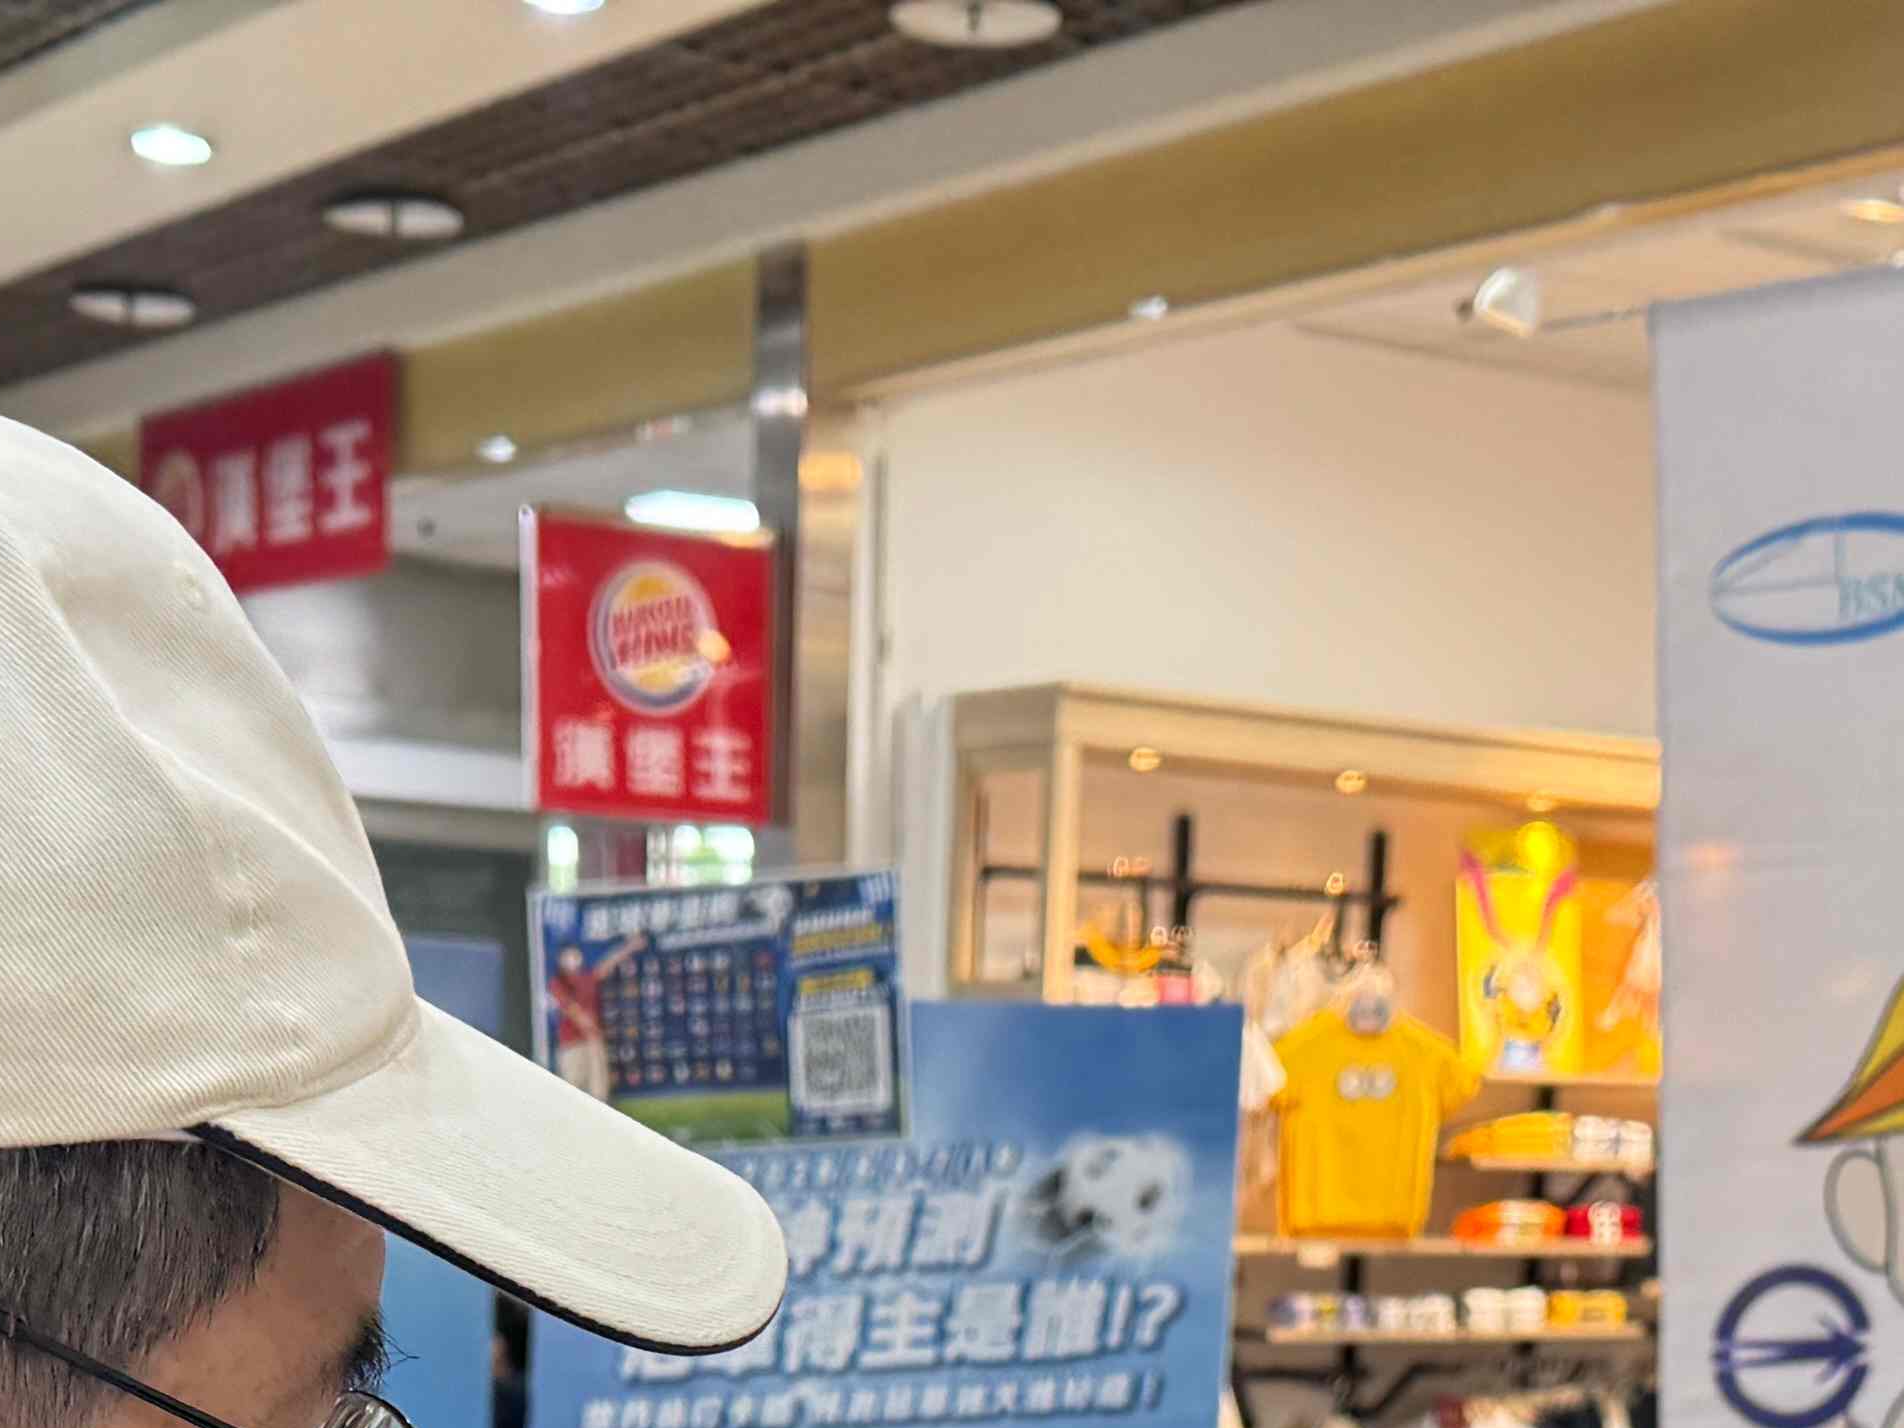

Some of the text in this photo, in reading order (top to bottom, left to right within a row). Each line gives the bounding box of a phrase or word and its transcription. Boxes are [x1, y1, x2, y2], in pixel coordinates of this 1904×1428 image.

[552, 718, 752, 800] 漢堡王
[620, 1278, 1182, 1381] 得主是誰!?
